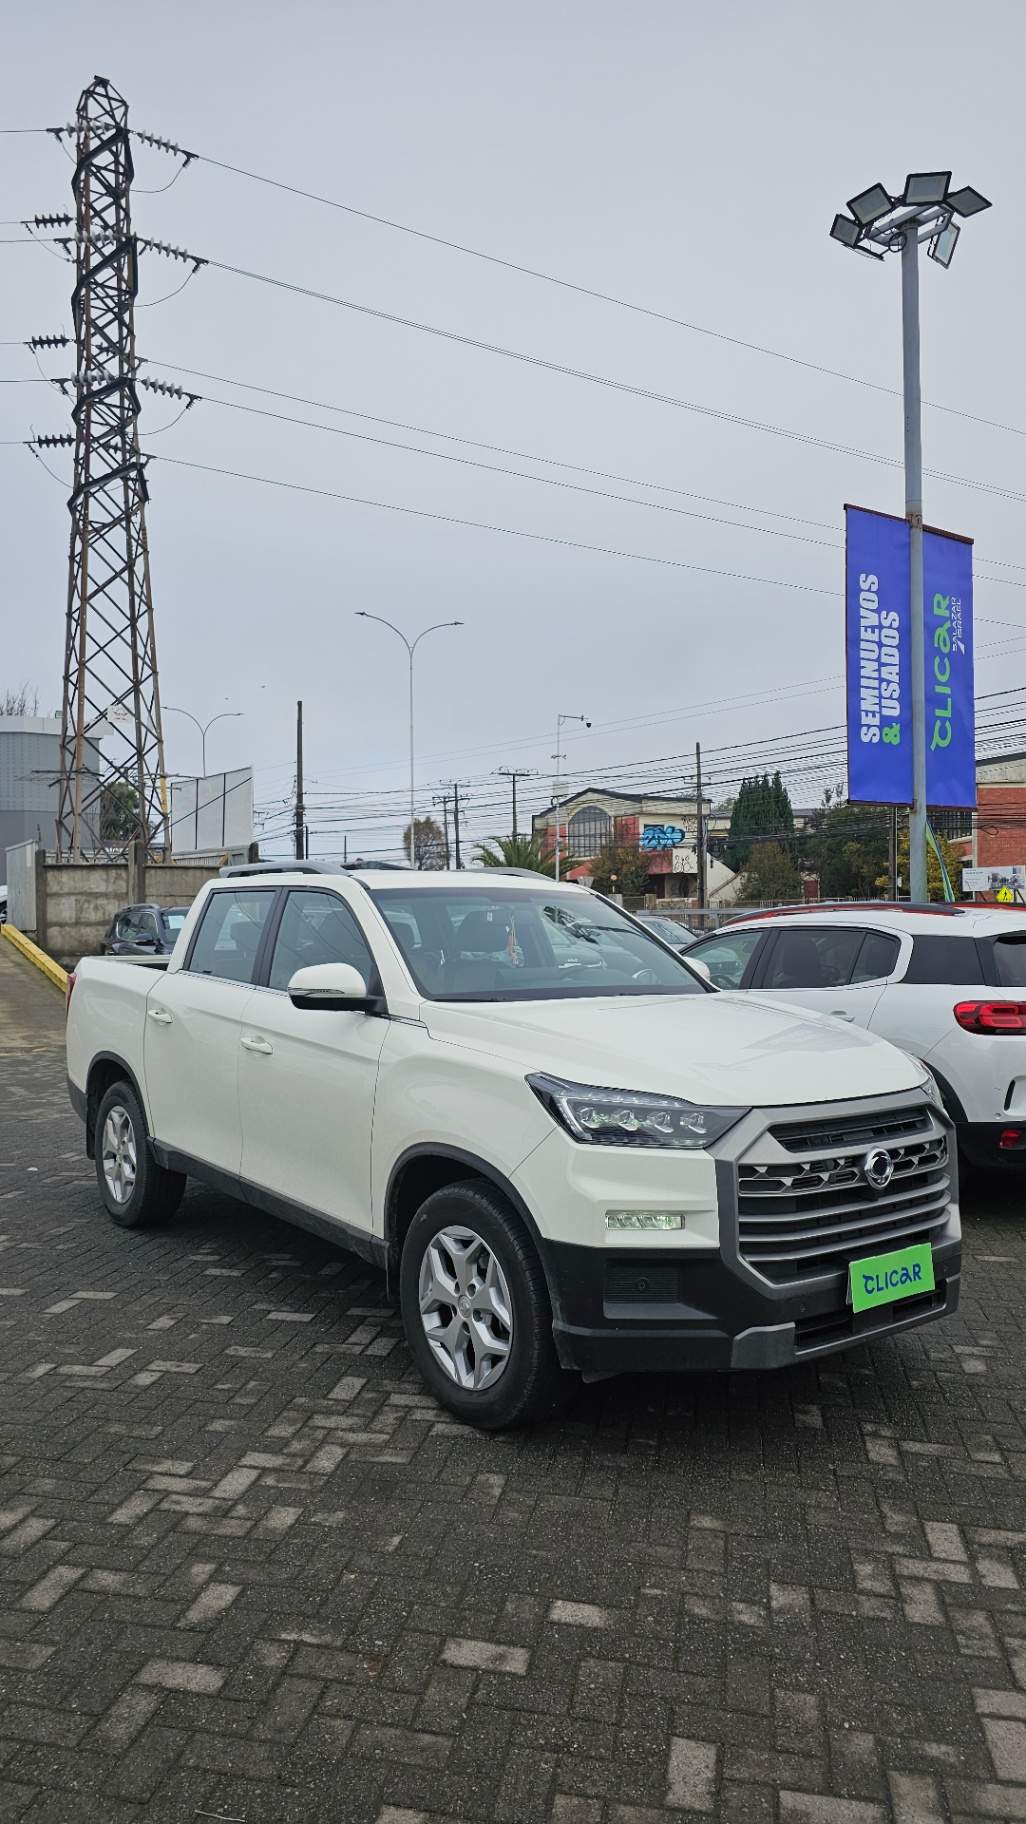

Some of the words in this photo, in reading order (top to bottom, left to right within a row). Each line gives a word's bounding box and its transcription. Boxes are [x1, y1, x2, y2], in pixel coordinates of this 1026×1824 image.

[859, 573, 880, 743] SEMINUEVOS
[881, 610, 901, 717] USADOS
[882, 722, 901, 746] &
